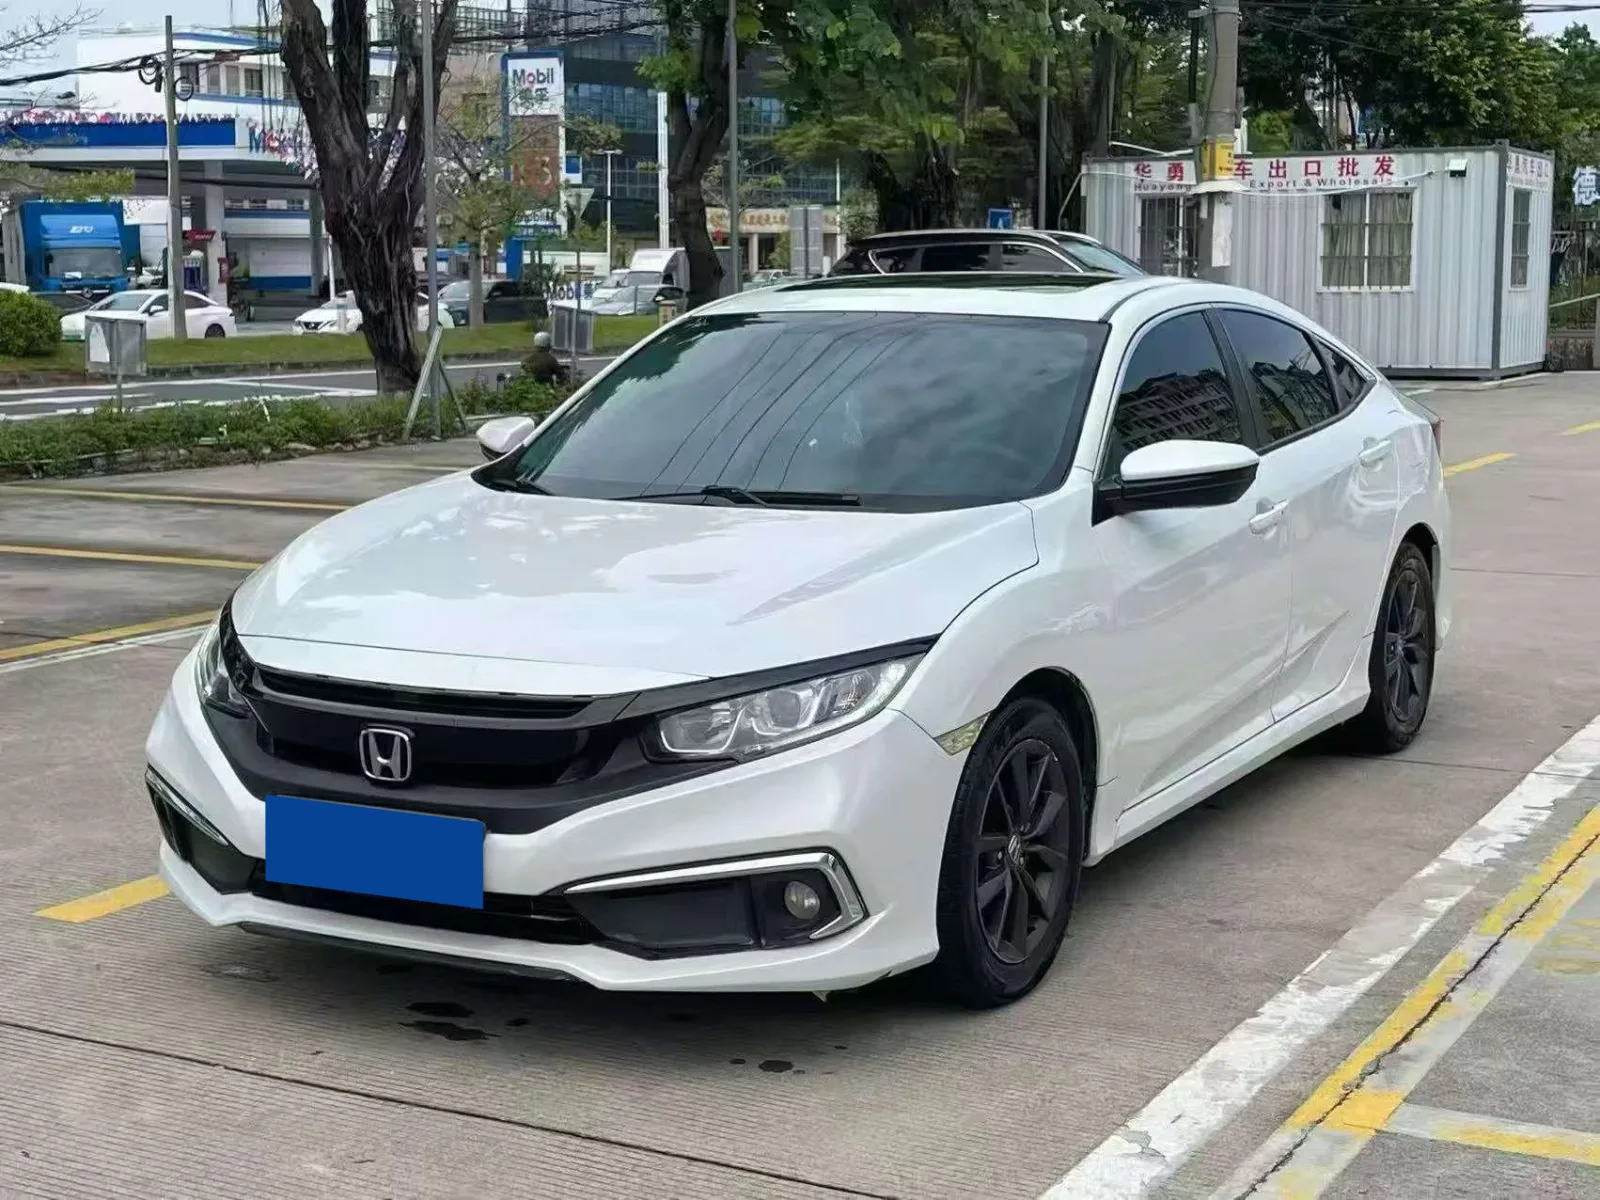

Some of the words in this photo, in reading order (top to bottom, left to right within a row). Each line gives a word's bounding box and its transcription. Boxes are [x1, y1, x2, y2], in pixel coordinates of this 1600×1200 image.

[512, 67, 555, 86] Mobil
[1134, 155, 1395, 181] 华勇车出口批发
[1249, 179, 1297, 189] Export
